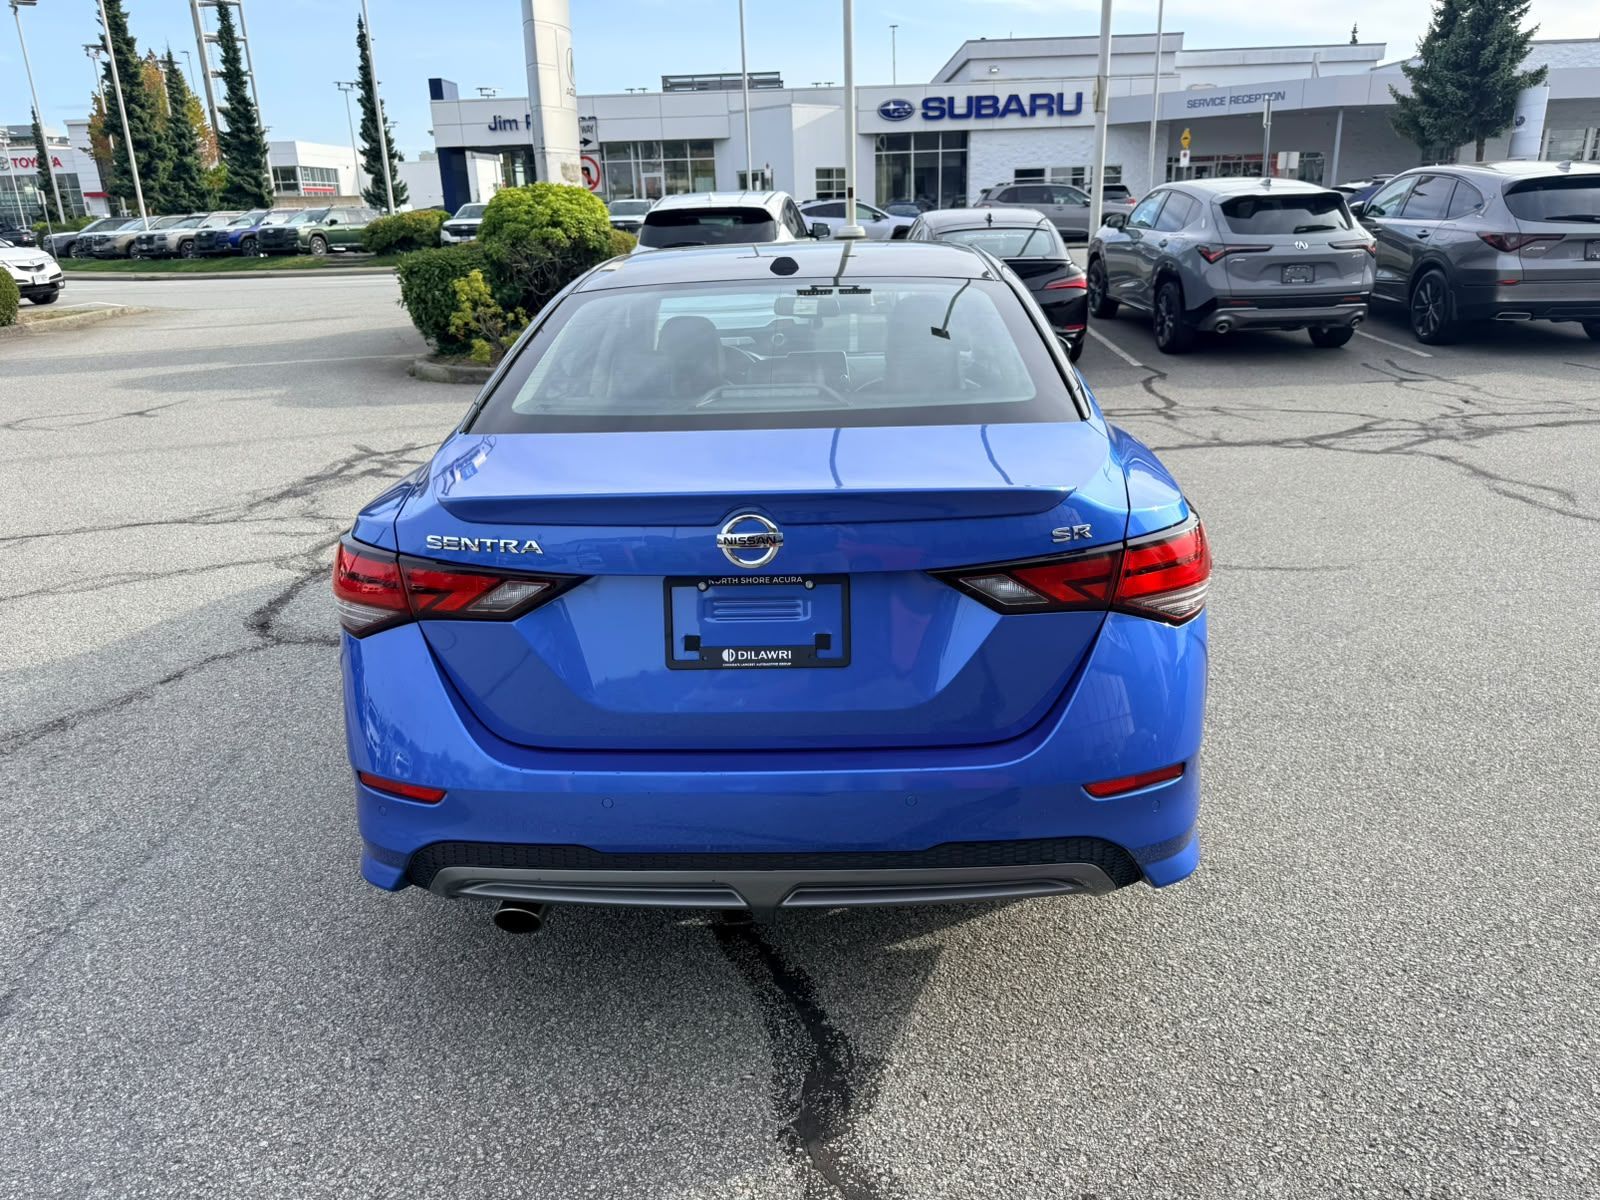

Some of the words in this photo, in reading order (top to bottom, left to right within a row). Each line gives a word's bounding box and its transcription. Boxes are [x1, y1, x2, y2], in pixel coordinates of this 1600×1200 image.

[921, 92, 1083, 121] SUBARU
[1187, 97, 1226, 109] SERVICE
[1229, 91, 1286, 105] RECEPTON
[488, 114, 519, 131] Jim
[11, 156, 63, 168] TOYA
[723, 535, 776, 545] NISSAN
[1052, 523, 1093, 543] SR
[426, 534, 543, 554] SENTRA
[740, 576, 770, 584] SHORE
[738, 650, 791, 660] DILAWRI
